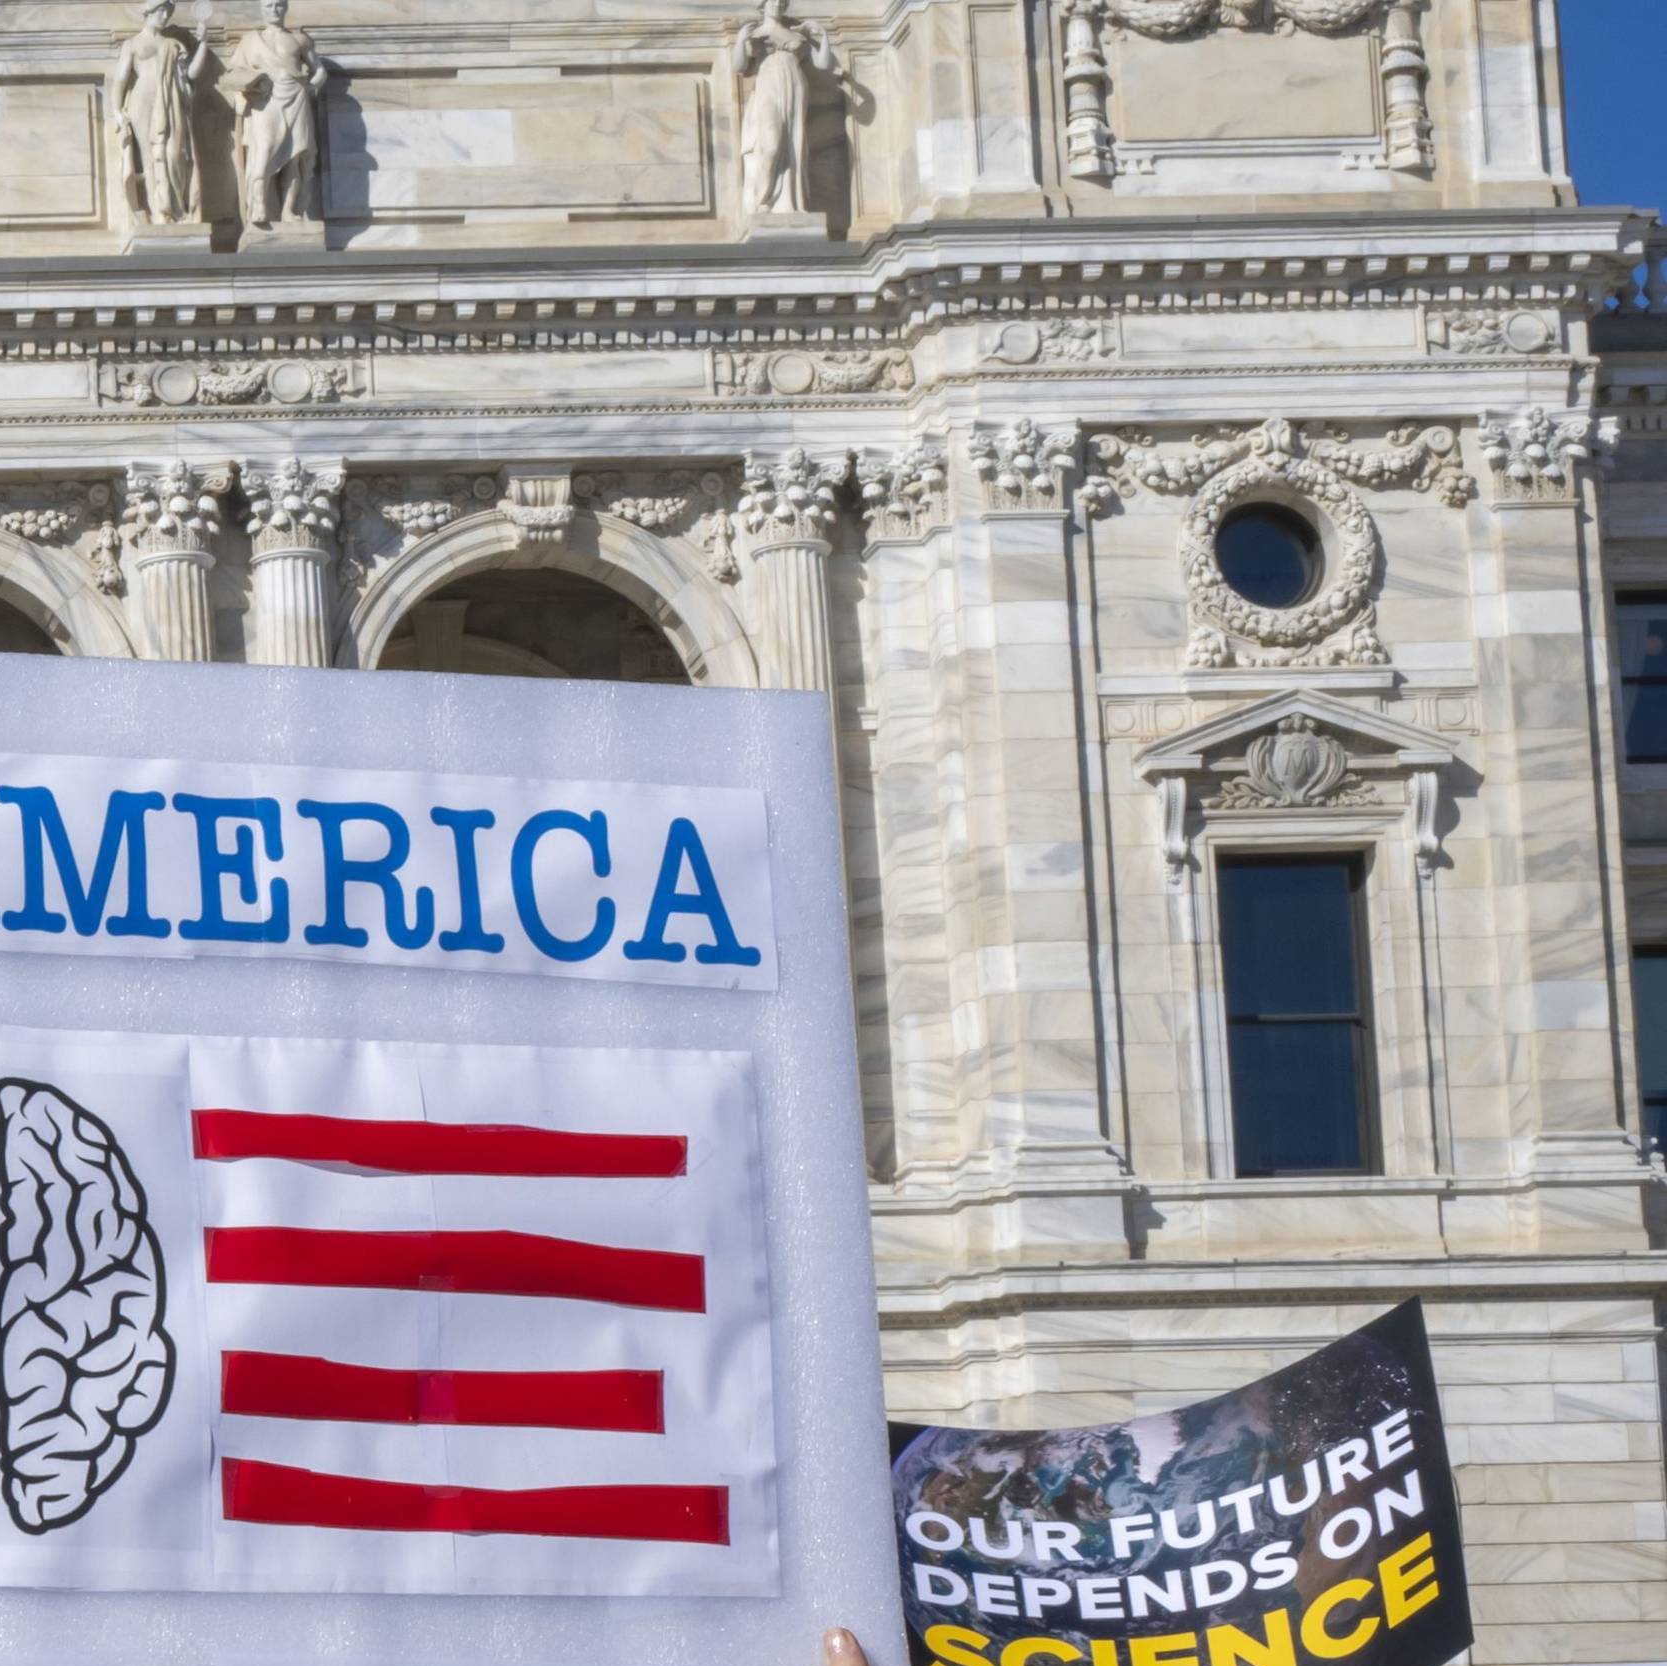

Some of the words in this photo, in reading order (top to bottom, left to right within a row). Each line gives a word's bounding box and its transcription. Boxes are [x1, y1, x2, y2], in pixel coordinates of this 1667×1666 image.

[905, 1511, 1084, 1562] OUR
[1109, 1407, 1415, 1559] FUTURE
[911, 1540, 1299, 1620] DEPENDS
[1319, 1468, 1425, 1561] ON
